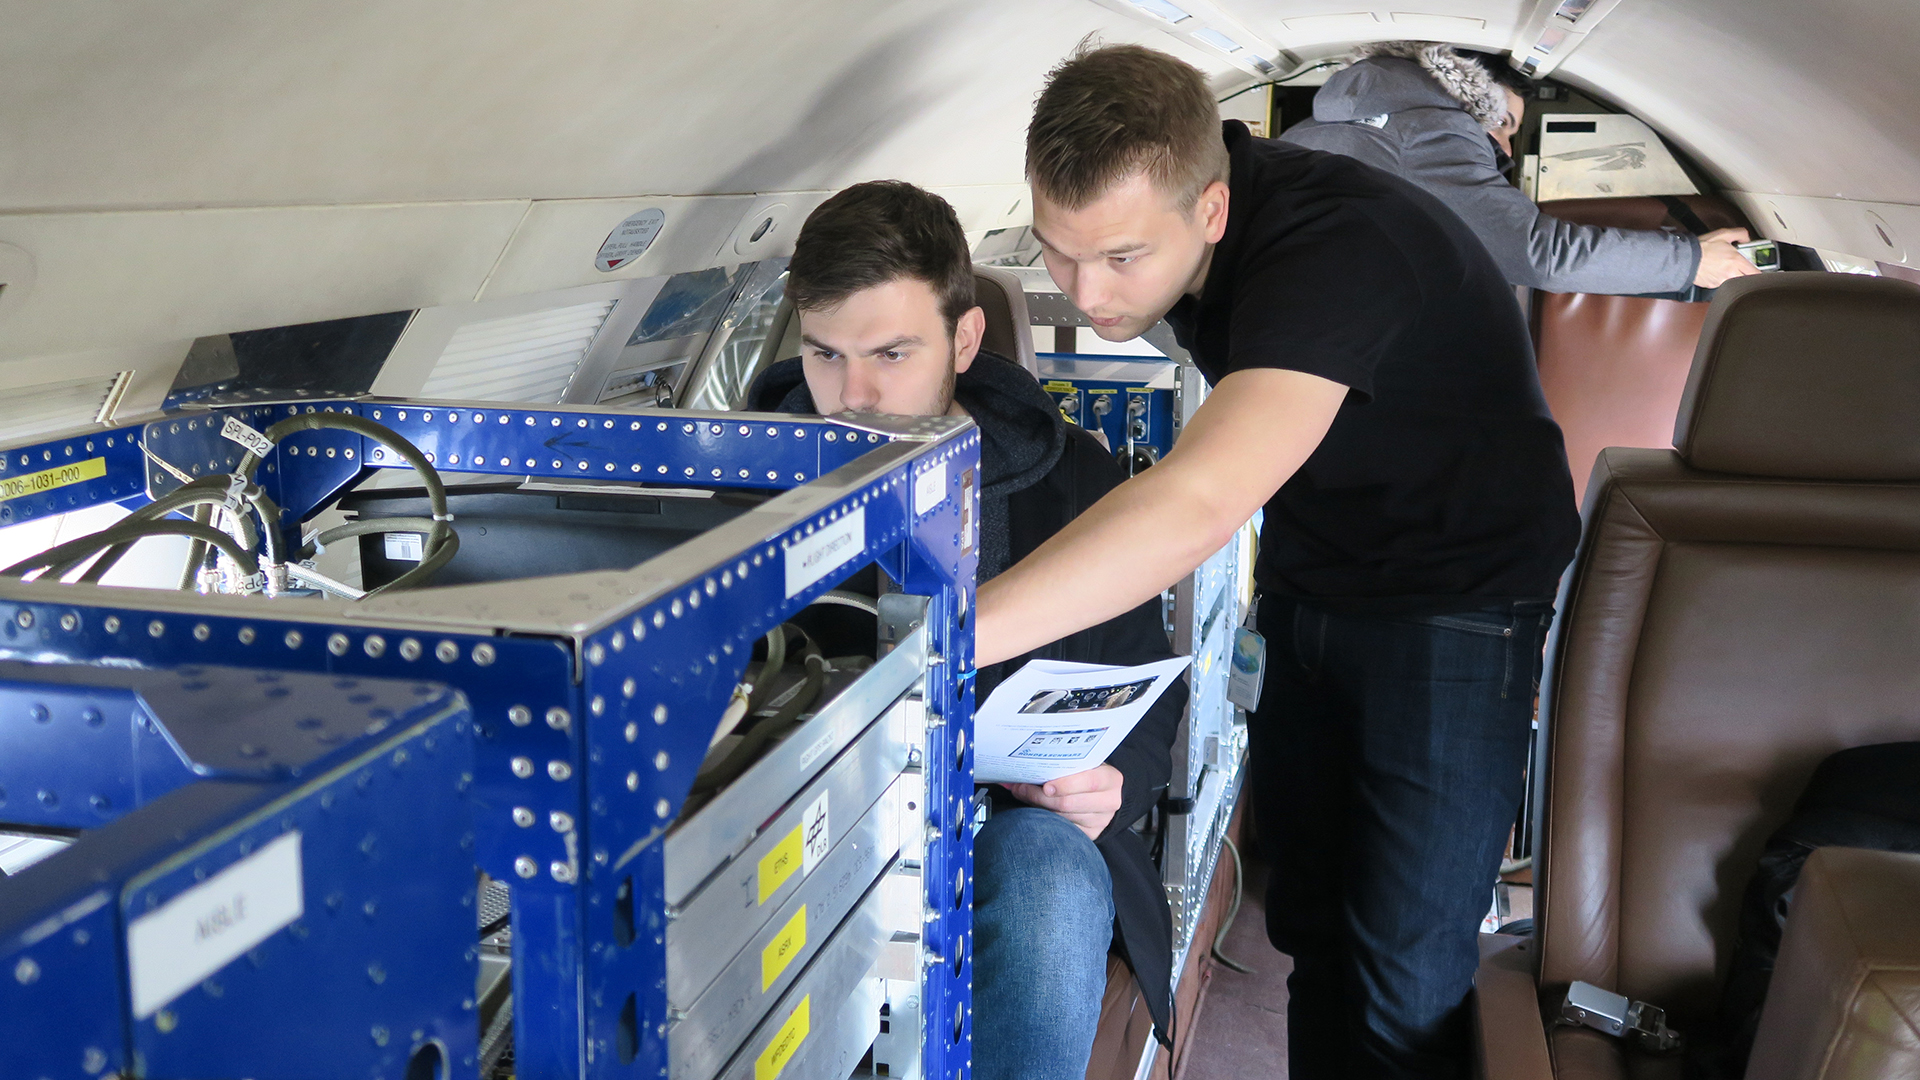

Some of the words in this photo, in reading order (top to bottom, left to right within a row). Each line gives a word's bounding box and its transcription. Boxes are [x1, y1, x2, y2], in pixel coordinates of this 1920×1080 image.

[648, 218, 660, 226] EXIT
[225, 421, 269, 454] SPL-P02
[817, 837, 827, 858] DLR
